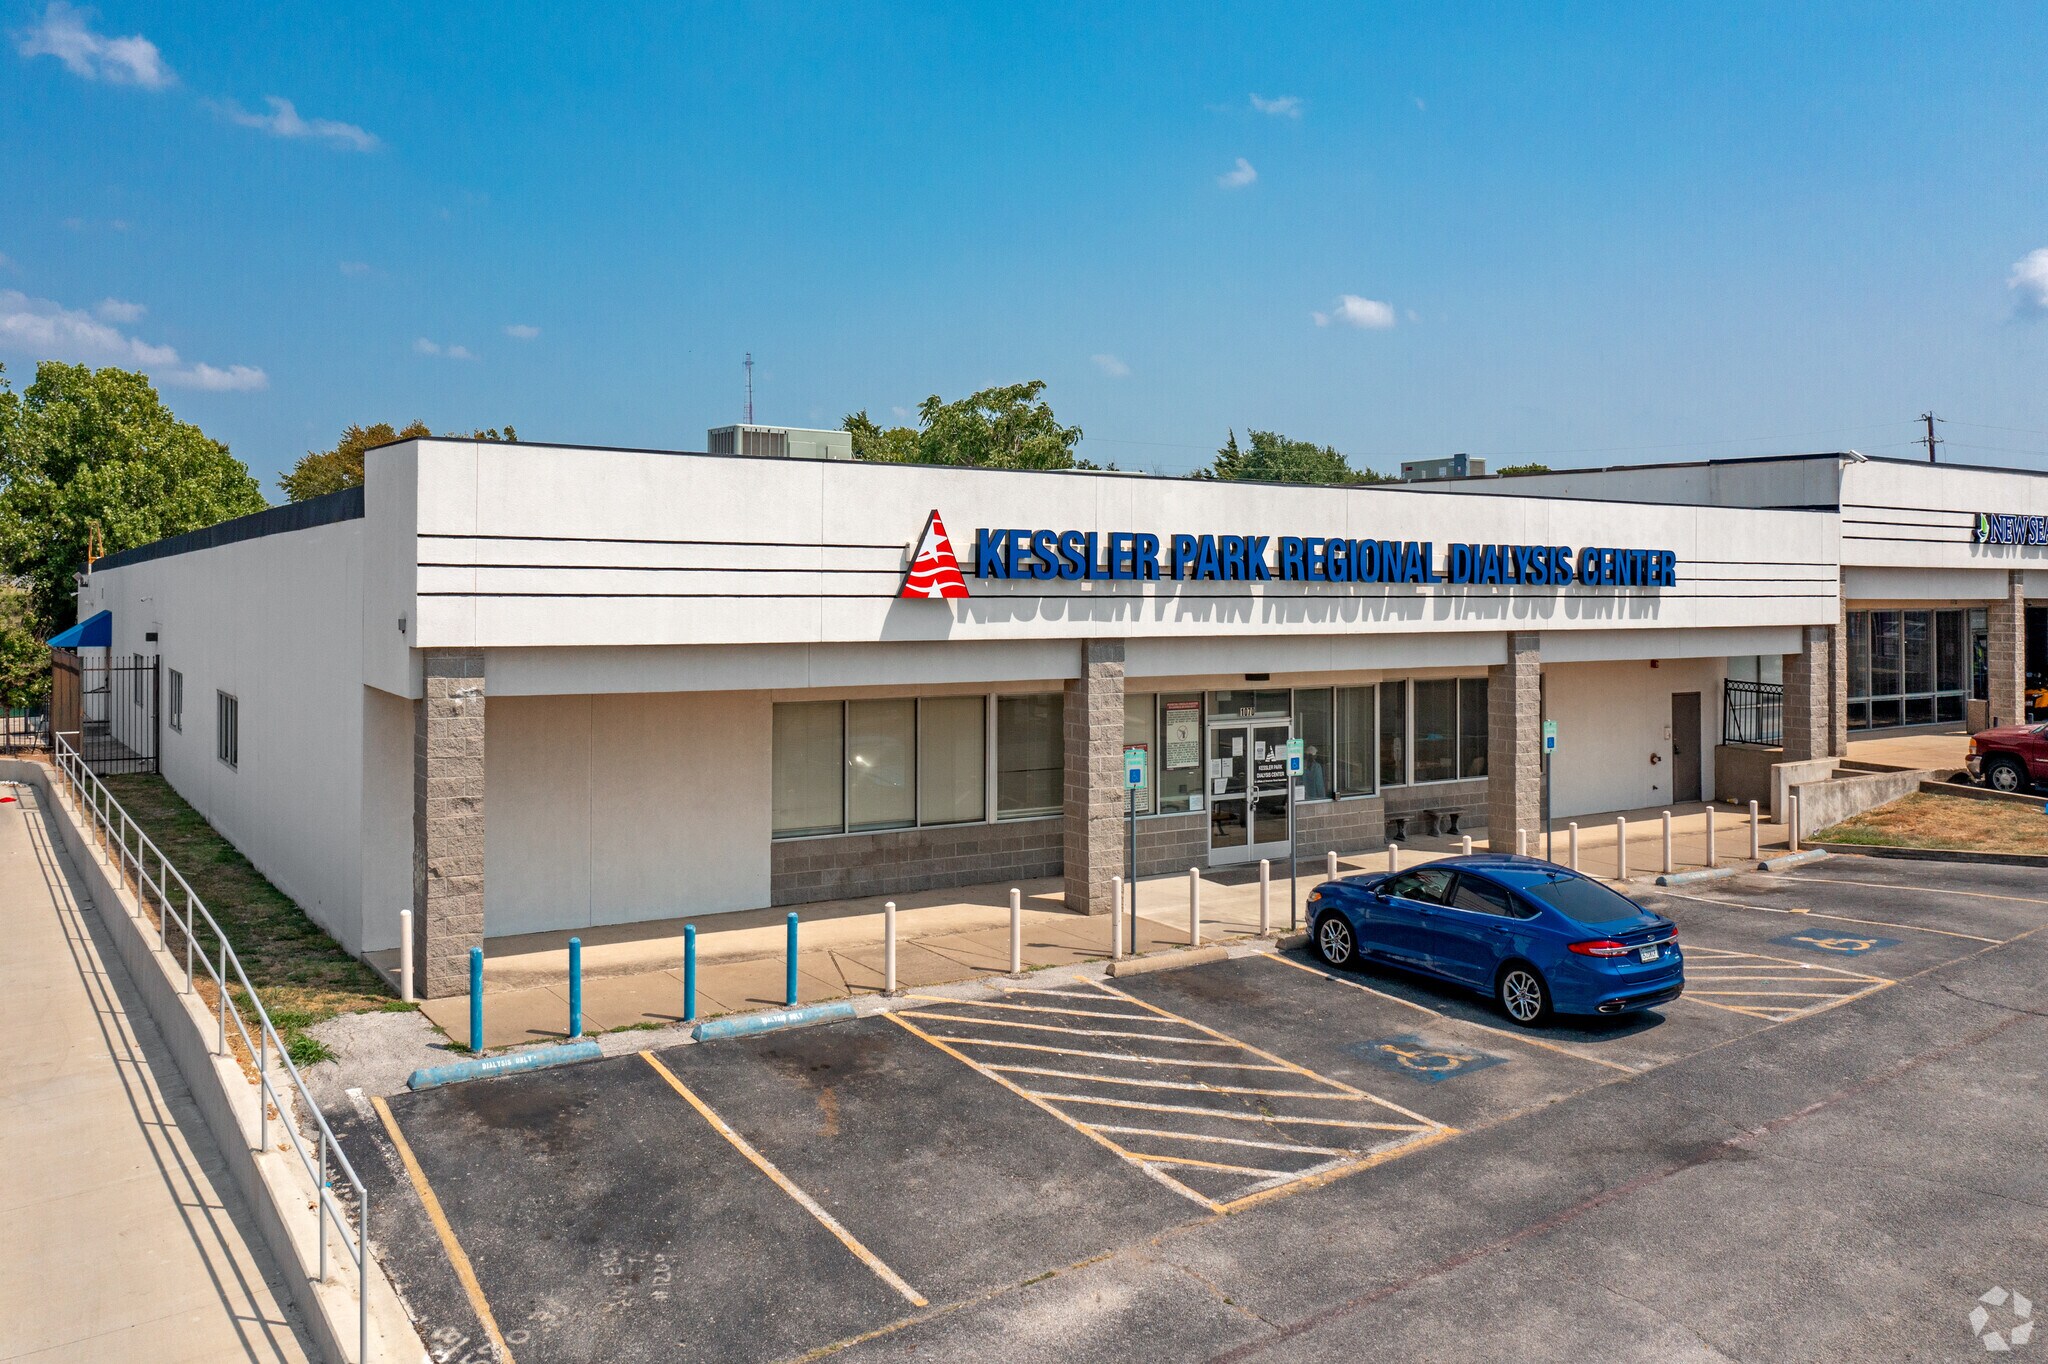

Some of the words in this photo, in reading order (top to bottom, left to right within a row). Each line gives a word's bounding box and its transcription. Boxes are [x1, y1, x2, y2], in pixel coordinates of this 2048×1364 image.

[1990, 514, 2028, 544] NEW
[976, 528, 1160, 580] KESSLER
[1171, 534, 1272, 581] PARK
[1278, 536, 1442, 583] REGIONAL
[1448, 543, 1573, 586] DIALYSIS
[1578, 547, 1677, 588] CENTER
[482, 1059, 512, 1070] DIALYSIS
[515, 1055, 532, 1064] ONLY
